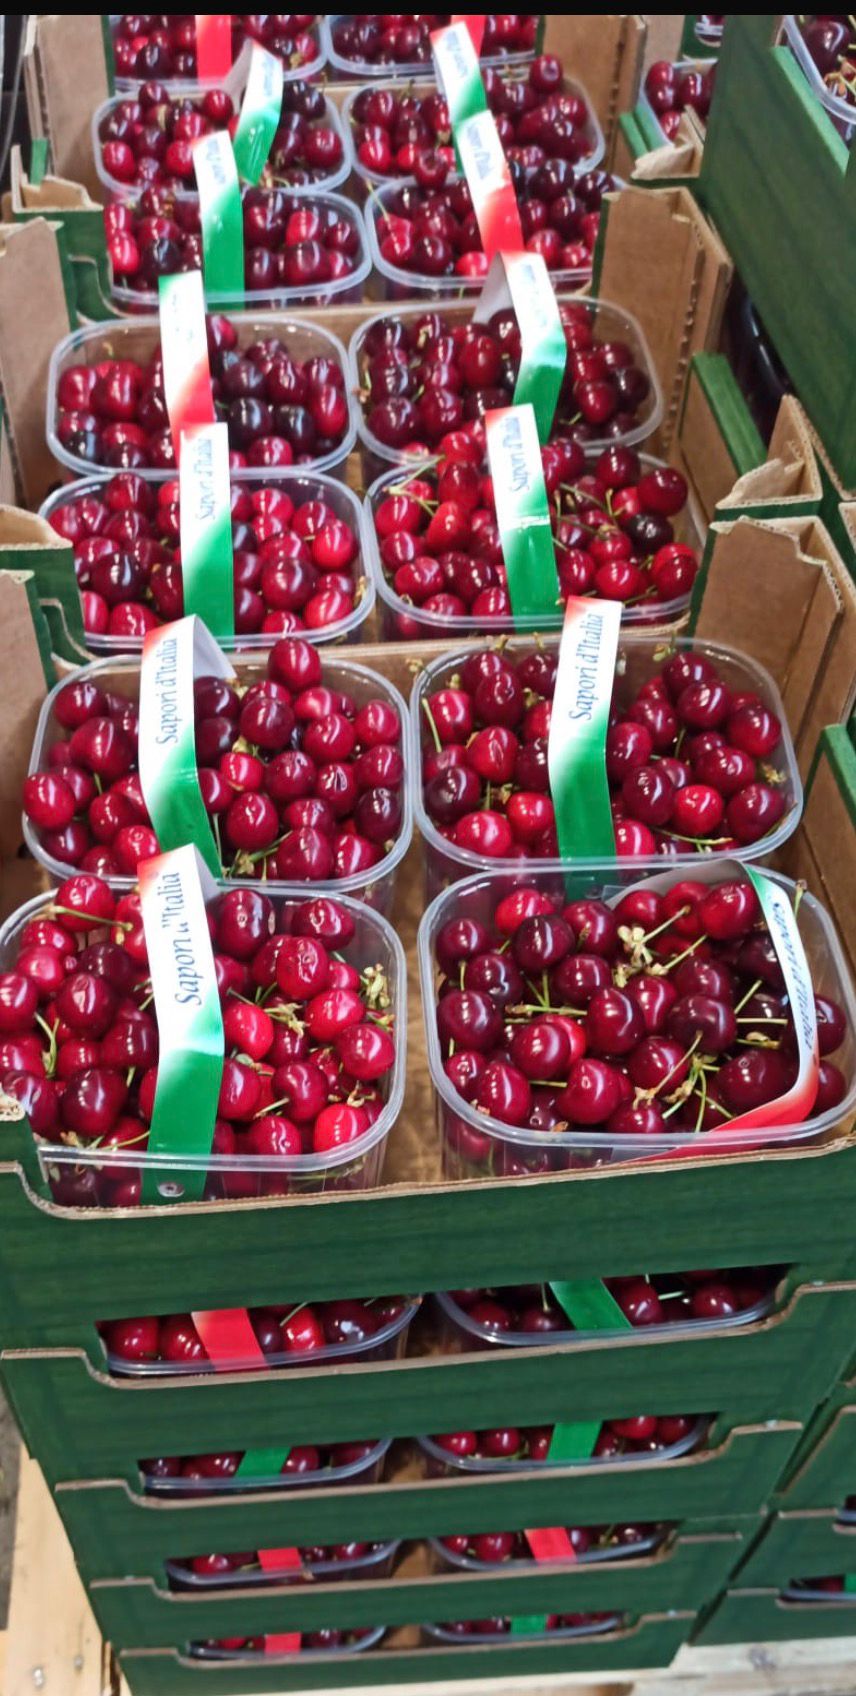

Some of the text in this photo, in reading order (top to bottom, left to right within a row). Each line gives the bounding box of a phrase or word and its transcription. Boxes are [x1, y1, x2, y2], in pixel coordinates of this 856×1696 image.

[155, 638, 182, 744] Sapori d'Italia
[568, 613, 604, 721] Sapori d'Italia
